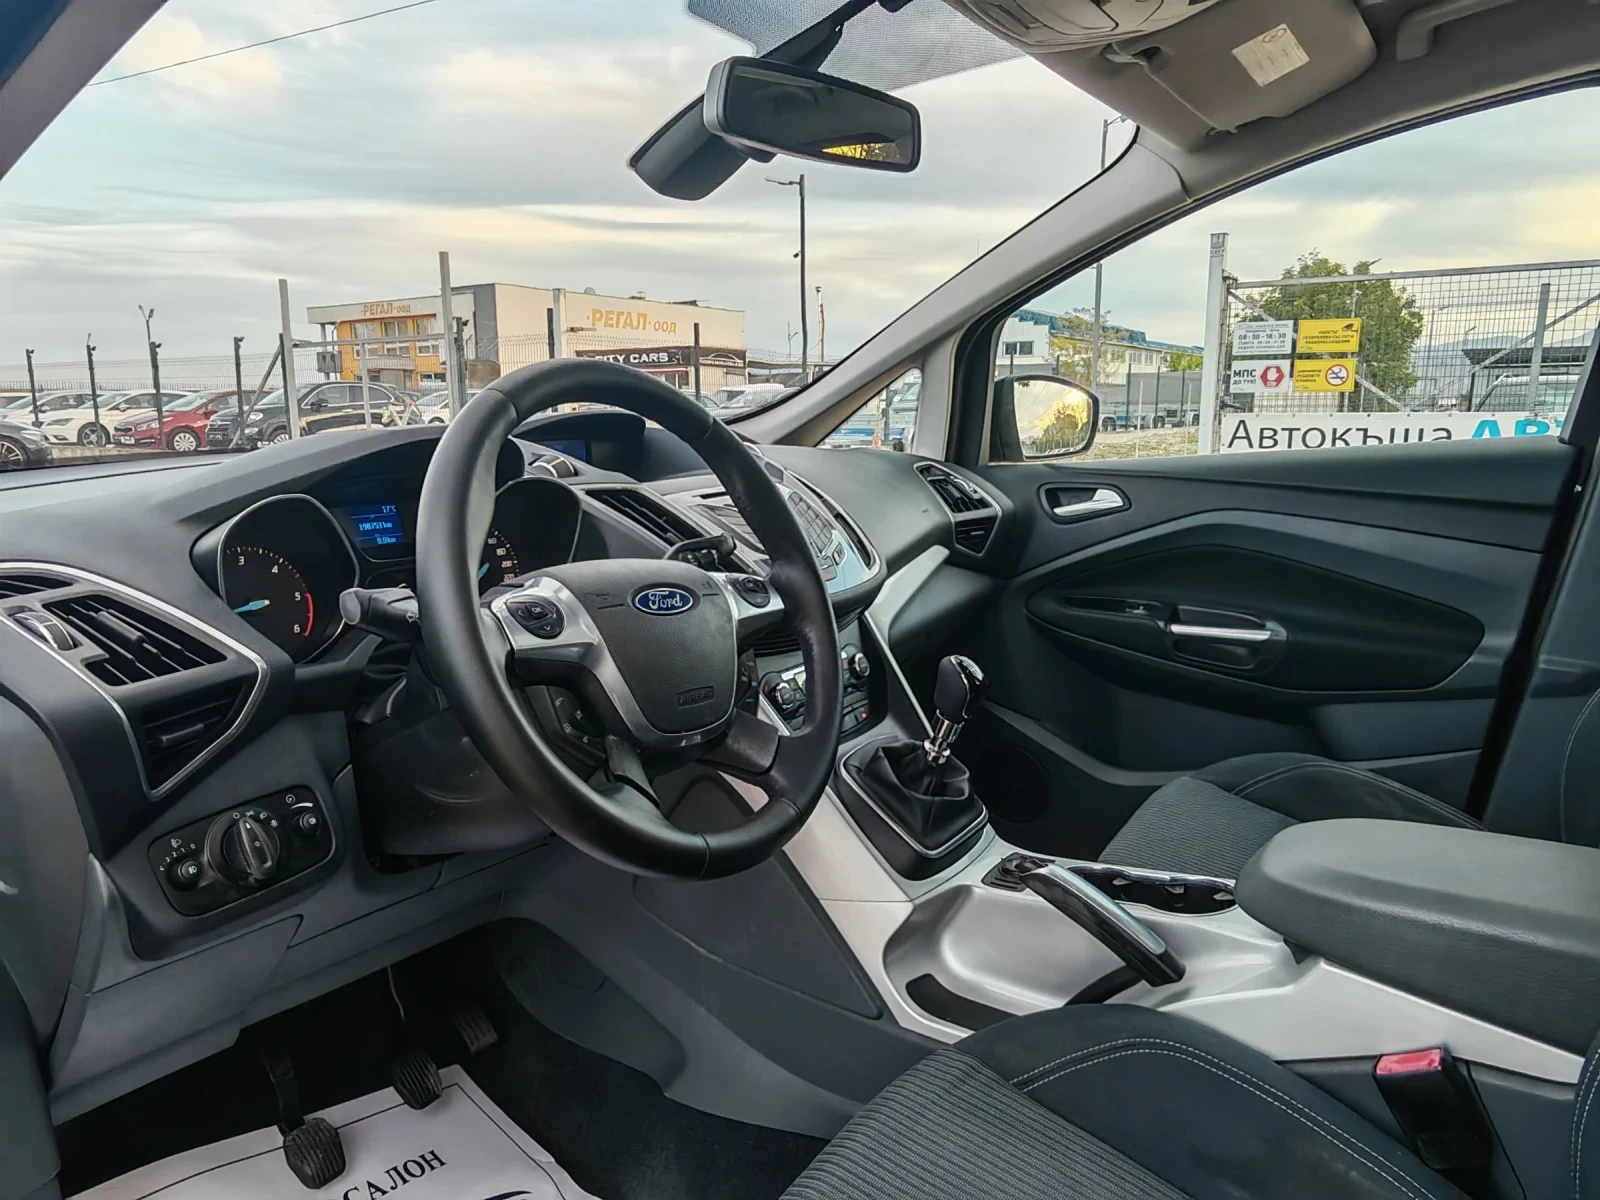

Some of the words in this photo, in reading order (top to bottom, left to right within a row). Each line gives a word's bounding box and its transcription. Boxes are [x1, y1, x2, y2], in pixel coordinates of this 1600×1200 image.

[363, 302, 393, 316] РЕГАЛ
[591, 308, 648, 331] РЕГАЛ
[653, 320, 677, 335] ООД
[629, 352, 669, 363] CARS
[1233, 369, 1257, 378] МПС
[238, 556, 245, 565] 3
[271, 565, 279, 573] 4
[294, 592, 301, 601] 5
[648, 589, 683, 609] Ford
[293, 624, 300, 633] 6
